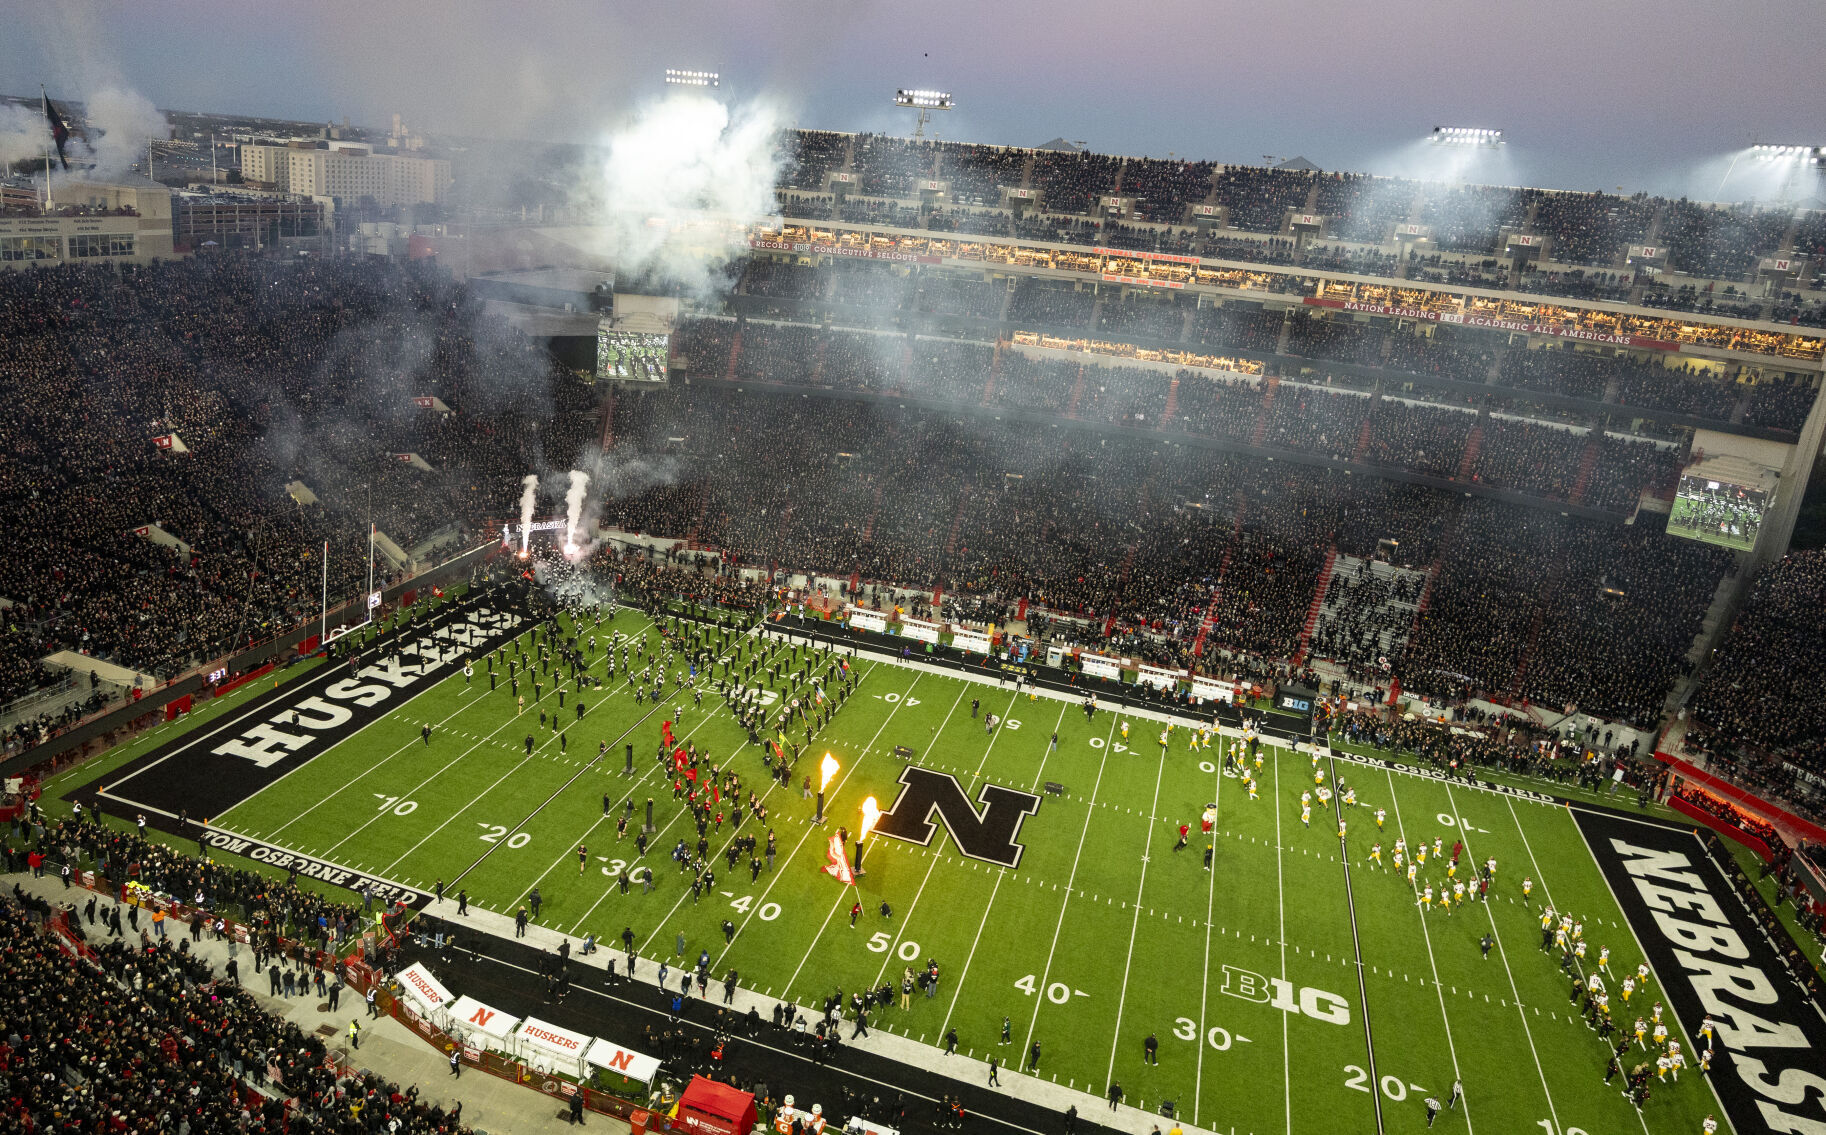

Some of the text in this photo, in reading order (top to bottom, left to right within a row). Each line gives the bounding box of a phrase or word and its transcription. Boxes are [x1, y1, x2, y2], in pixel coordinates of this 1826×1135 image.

[756, 241, 790, 250] RECORD
[814, 246, 873, 258] CONSECUTIVE
[876, 252, 918, 262] SELLOUTS
[1093, 247, 1200, 264] NATIONAL CHAMPIONSHIPS
[1344, 302, 1384, 313] NATION
[1389, 307, 1436, 320] LEADING
[1468, 317, 1528, 331] ACADEMIC
[1534, 325, 1554, 335] ALL
[1560, 329, 1631, 345] AMERICANS
[210, 606, 522, 768] HUSKERS
[1341, 752, 1388, 767] TOM
[1494, 784, 1554, 803] FIELD
[869, 764, 1044, 870] N
[479, 826, 532, 848] 20
[204, 831, 249, 854] TOM
[250, 847, 351, 885] OSBORNE
[730, 895, 782, 921] 40
[866, 931, 921, 961] 50
[405, 970, 442, 1004] HUSKERS
[1014, 974, 1070, 1004] 40
[1609, 838, 1826, 1135] NEBRAS
[469, 1008, 496, 1026] N
[524, 1025, 580, 1051] HUSKERS
[1172, 1016, 1232, 1050] 30
[609, 1050, 635, 1070] N
[1343, 1064, 1407, 1102] 20
[780, 1124, 788, 1134] G
